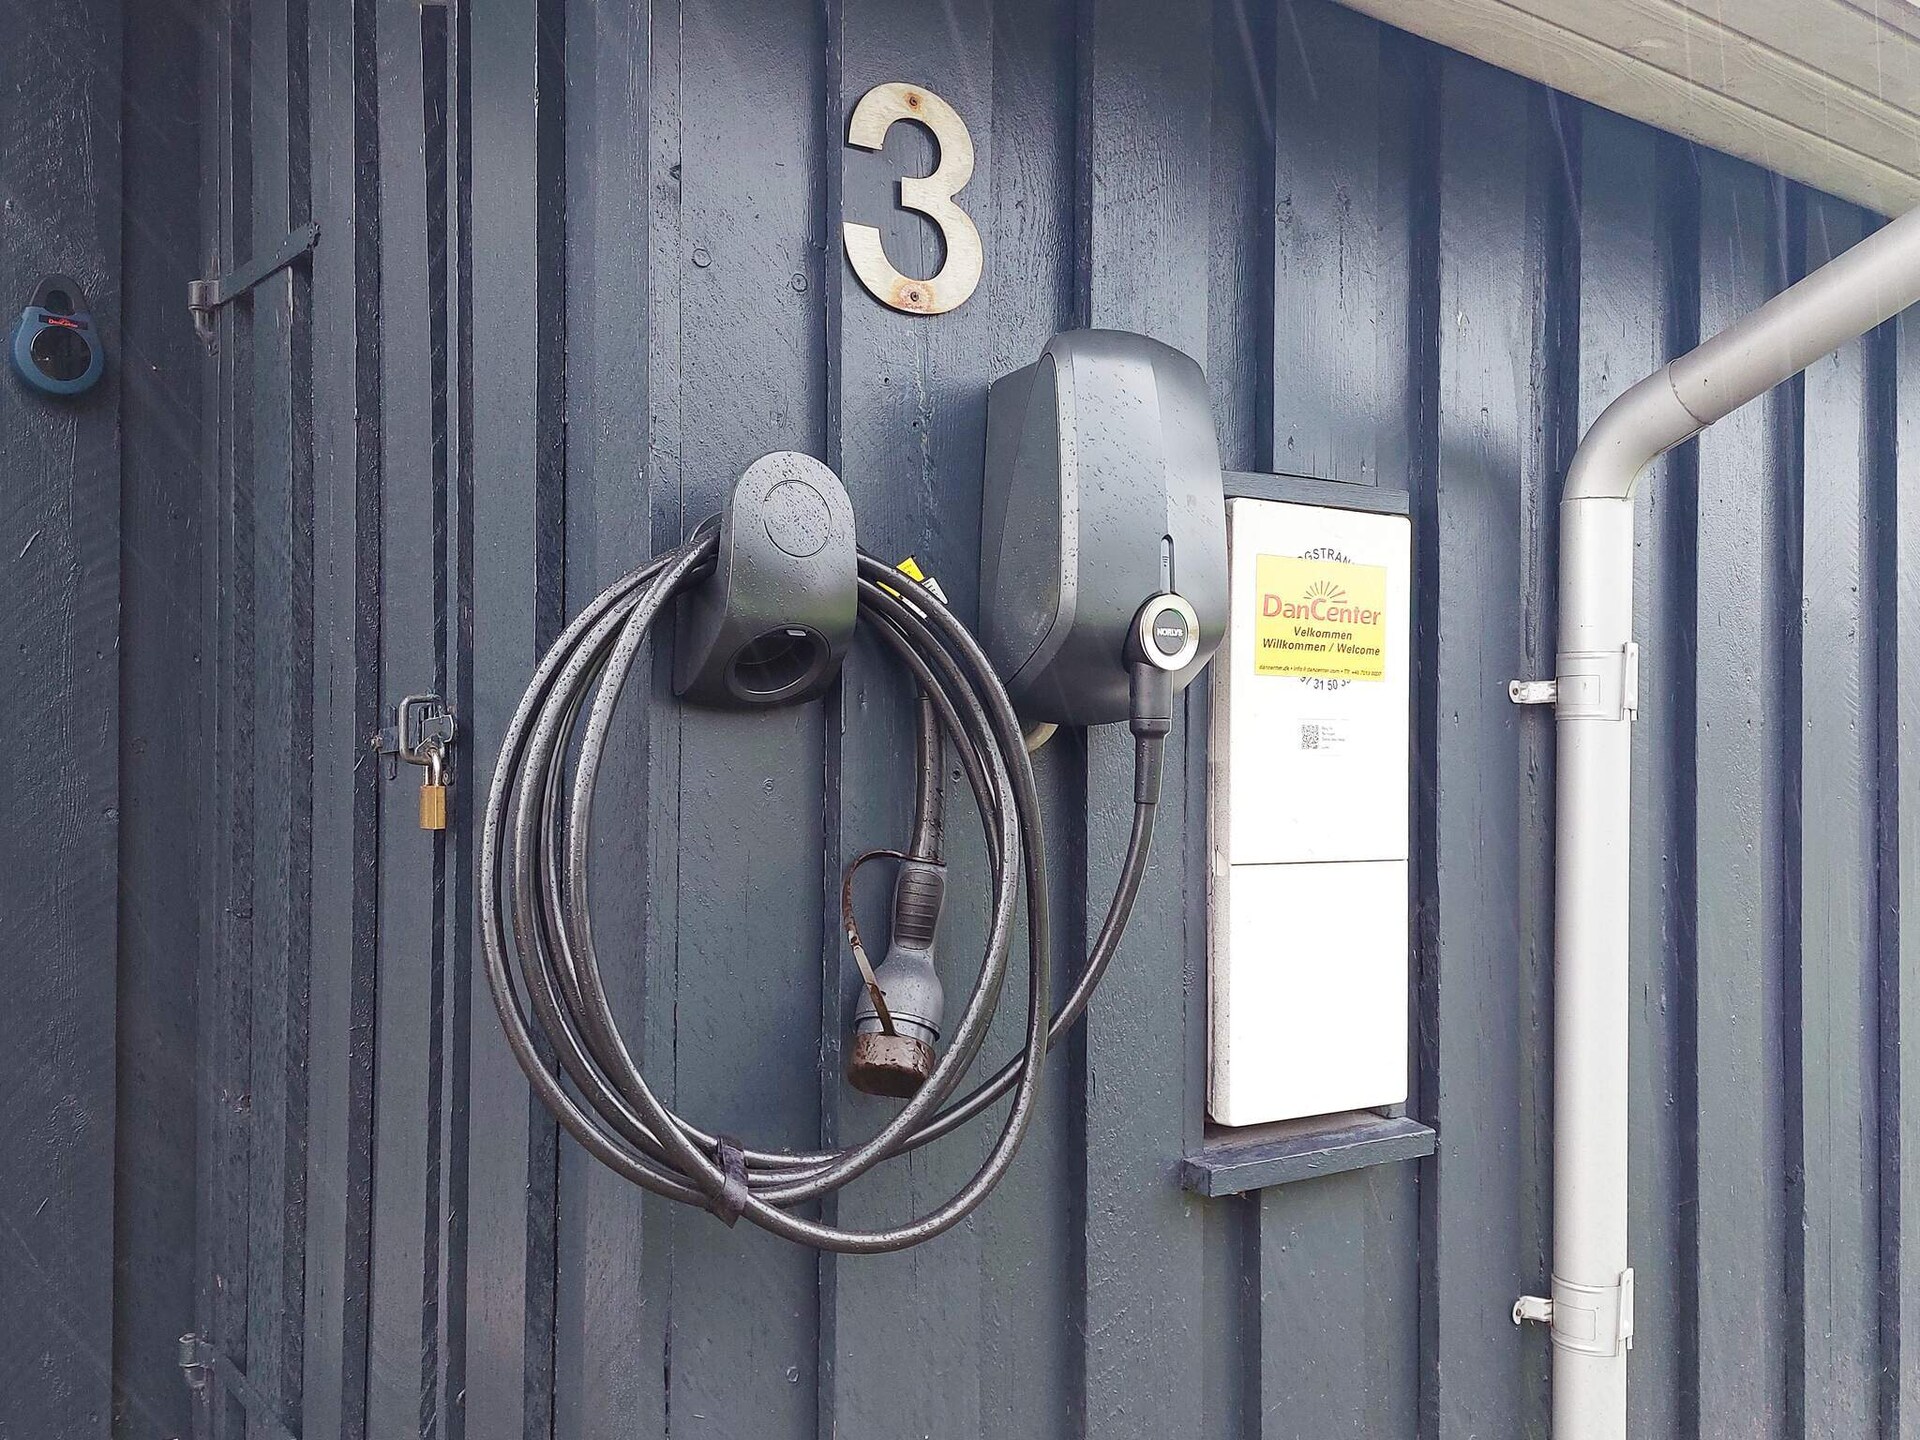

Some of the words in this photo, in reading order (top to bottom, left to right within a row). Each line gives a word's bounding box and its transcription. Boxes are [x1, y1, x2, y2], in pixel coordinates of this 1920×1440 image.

[843, 82, 983, 315] 3
[1262, 593, 1381, 625] DanCenter
[1294, 626, 1353, 640] Velkommen
[1262, 638, 1326, 652] Willkommen
[1337, 642, 1381, 656] Welcome
[1327, 679, 1338, 691] 50
